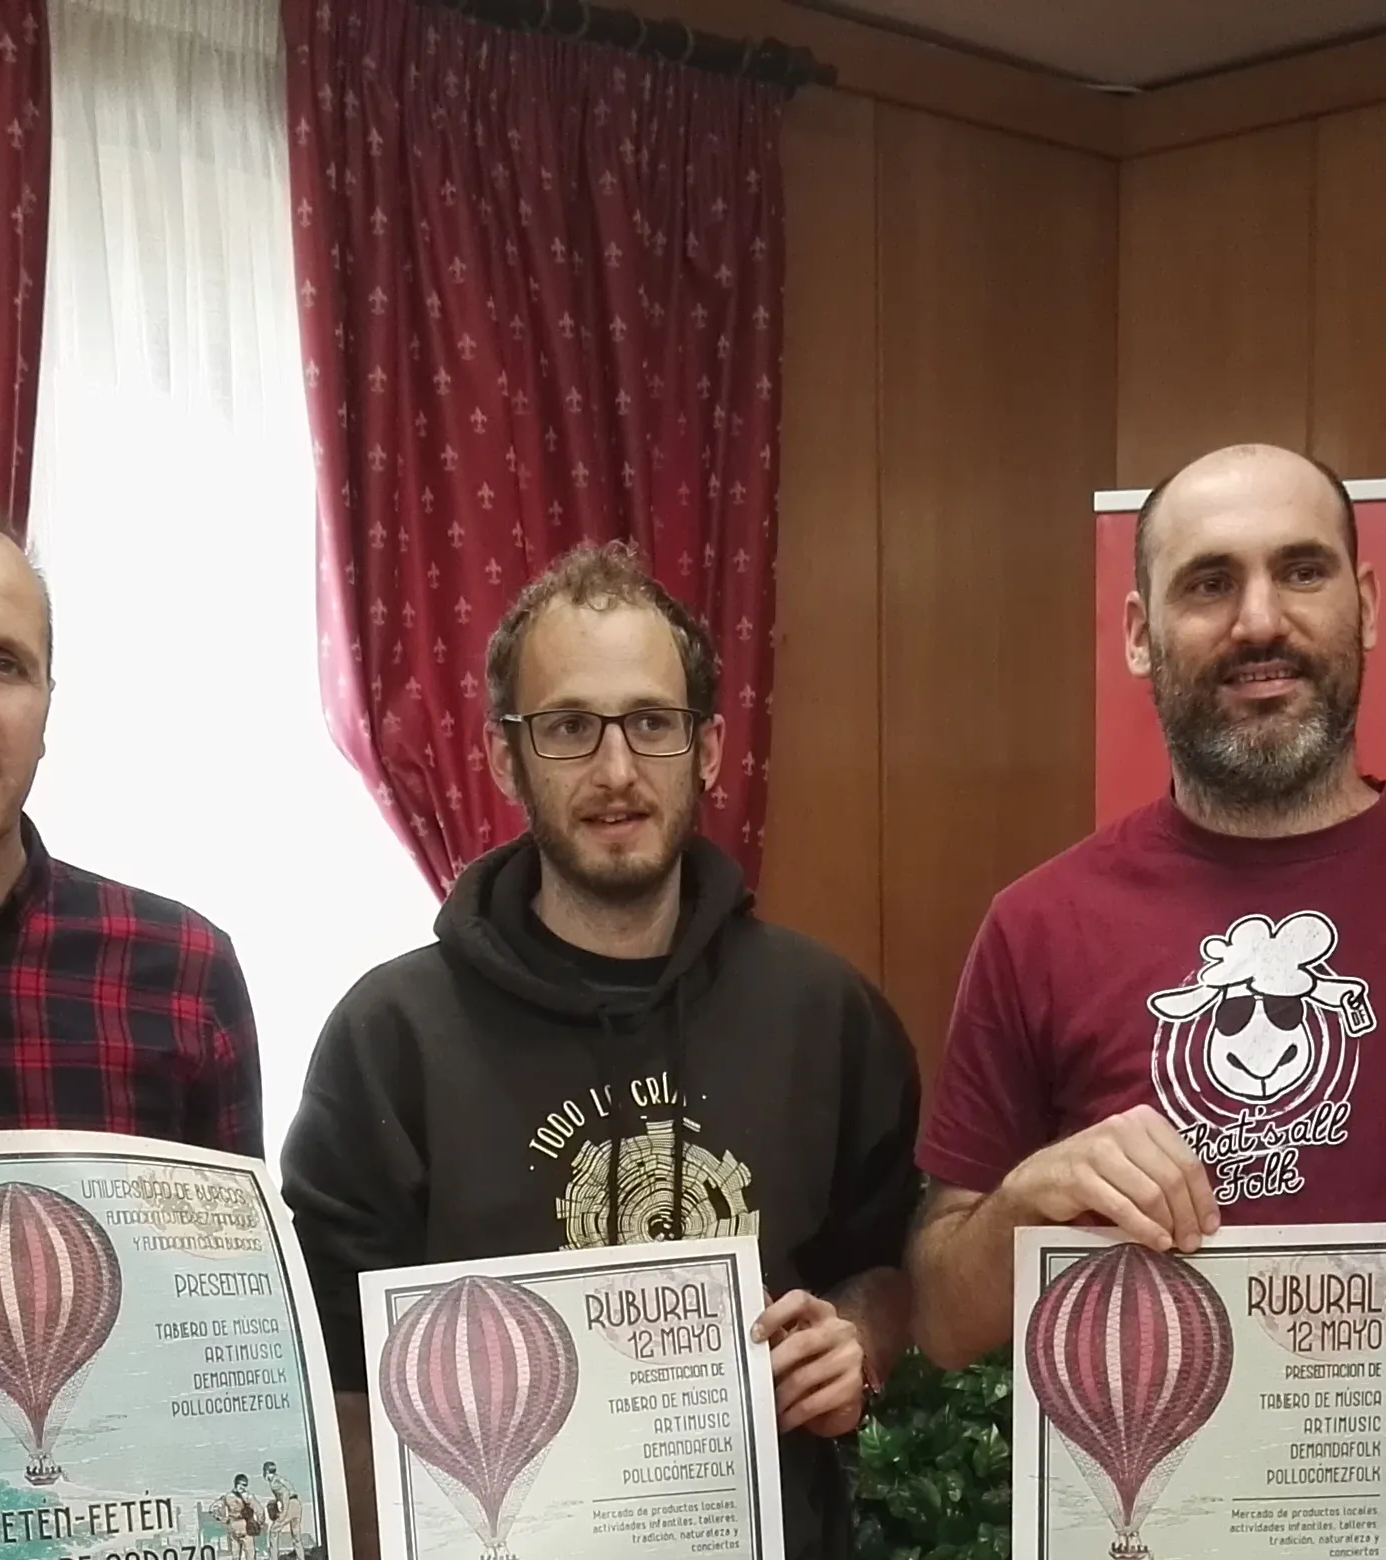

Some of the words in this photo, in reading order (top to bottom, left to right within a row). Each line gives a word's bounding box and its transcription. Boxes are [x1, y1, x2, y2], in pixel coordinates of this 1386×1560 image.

[529, 1100, 585, 1159] TODO
[1288, 1101, 1350, 1145] all
[1214, 1148, 1304, 1205] Folk
[81, 1179, 173, 1200] UNIVERSIDAD
[175, 1182, 193, 1200] DE
[175, 1273, 272, 1297] PRESENTAN
[1246, 1272, 1382, 1315] RUBURAL
[584, 1281, 718, 1329] RUBURAL
[212, 1320, 228, 1336] DE
[1287, 1321, 1312, 1351] 12
[1321, 1319, 1382, 1351] MAYO
[627, 1329, 654, 1359] 12
[660, 1323, 722, 1355] MAYO
[205, 1343, 283, 1363] ARTIMUSIC
[194, 1368, 287, 1390] DEMANDAFOLK
[662, 1393, 677, 1408] DE
[1315, 1392, 1330, 1407] DE
[654, 1411, 730, 1433] ARTIMUSIC
[1304, 1415, 1381, 1433] ARTIMUSIC
[643, 1438, 732, 1458] DEMANDAFOLK
[1290, 1441, 1380, 1459] DEMANDAFOLK
